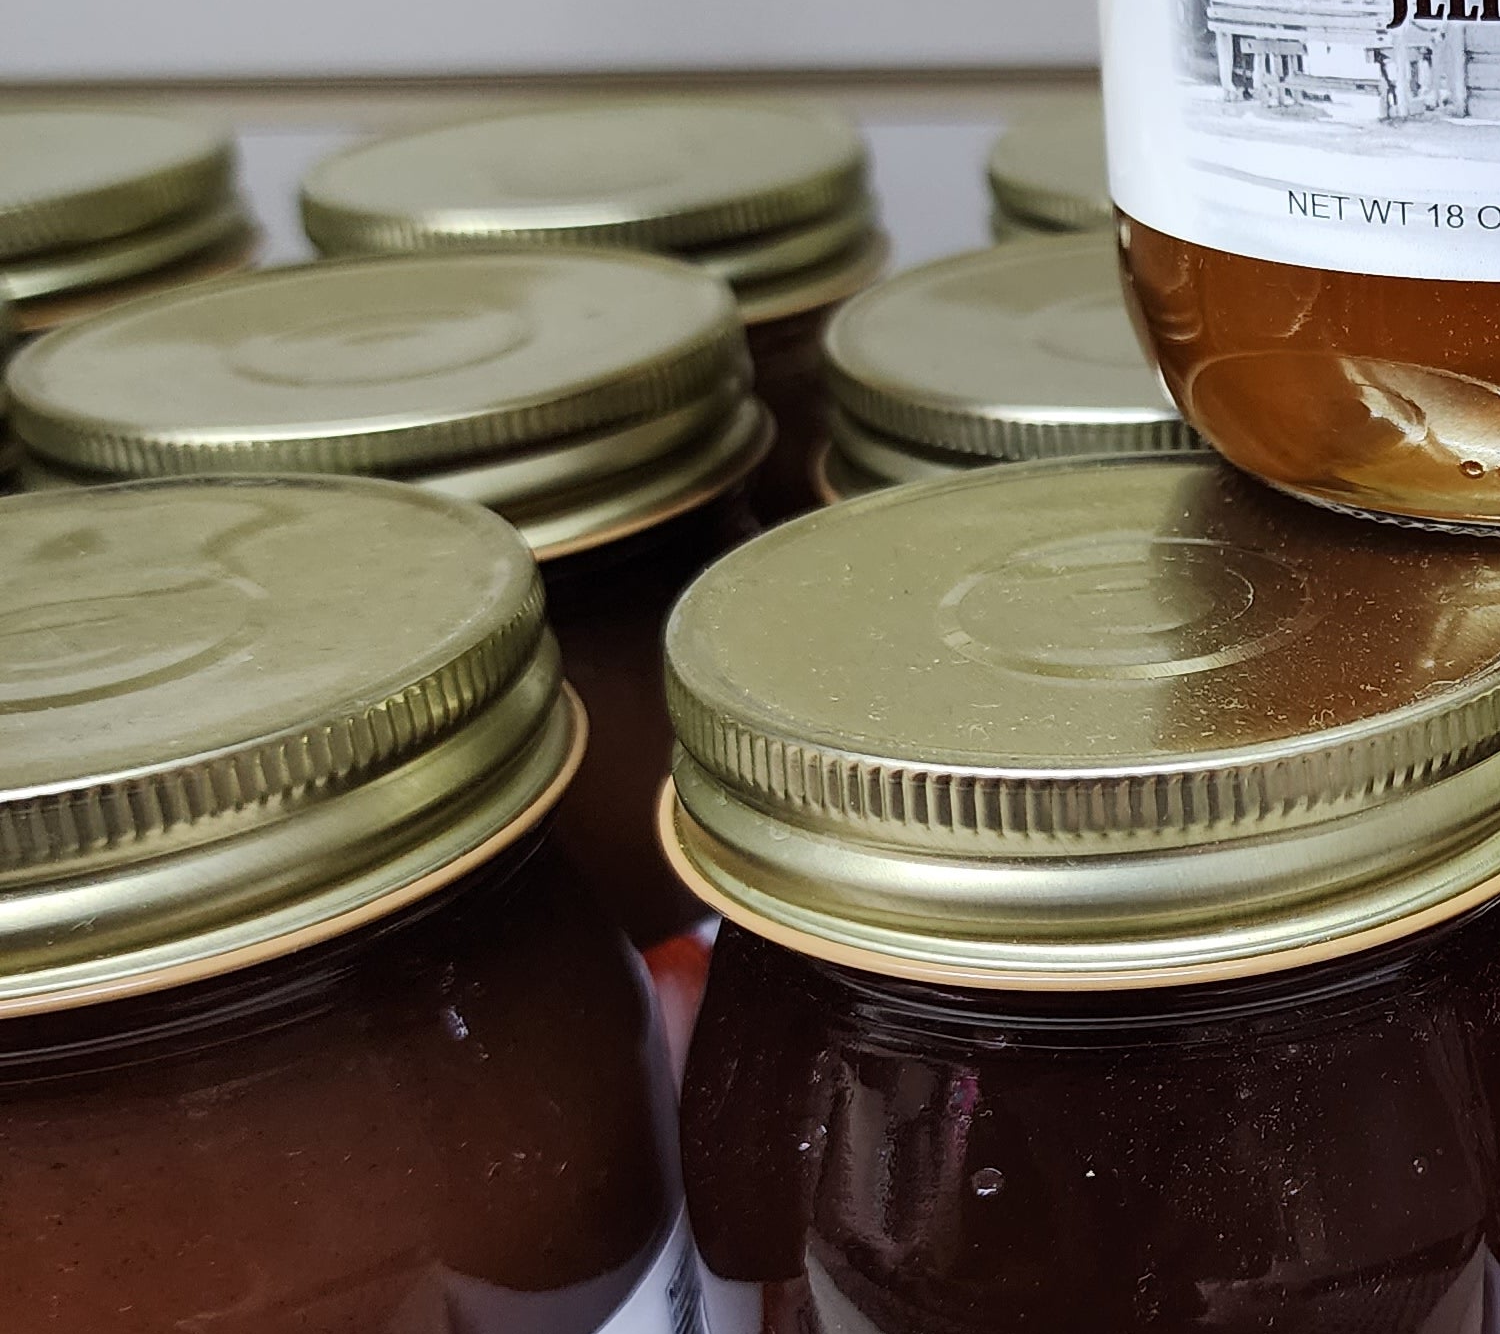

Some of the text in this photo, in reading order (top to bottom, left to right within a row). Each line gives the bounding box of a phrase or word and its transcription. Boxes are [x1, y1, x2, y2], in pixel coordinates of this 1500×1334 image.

[1286, 189, 1353, 224] NET
[1359, 196, 1414, 227] WT
[1426, 202, 1468, 230] 18
